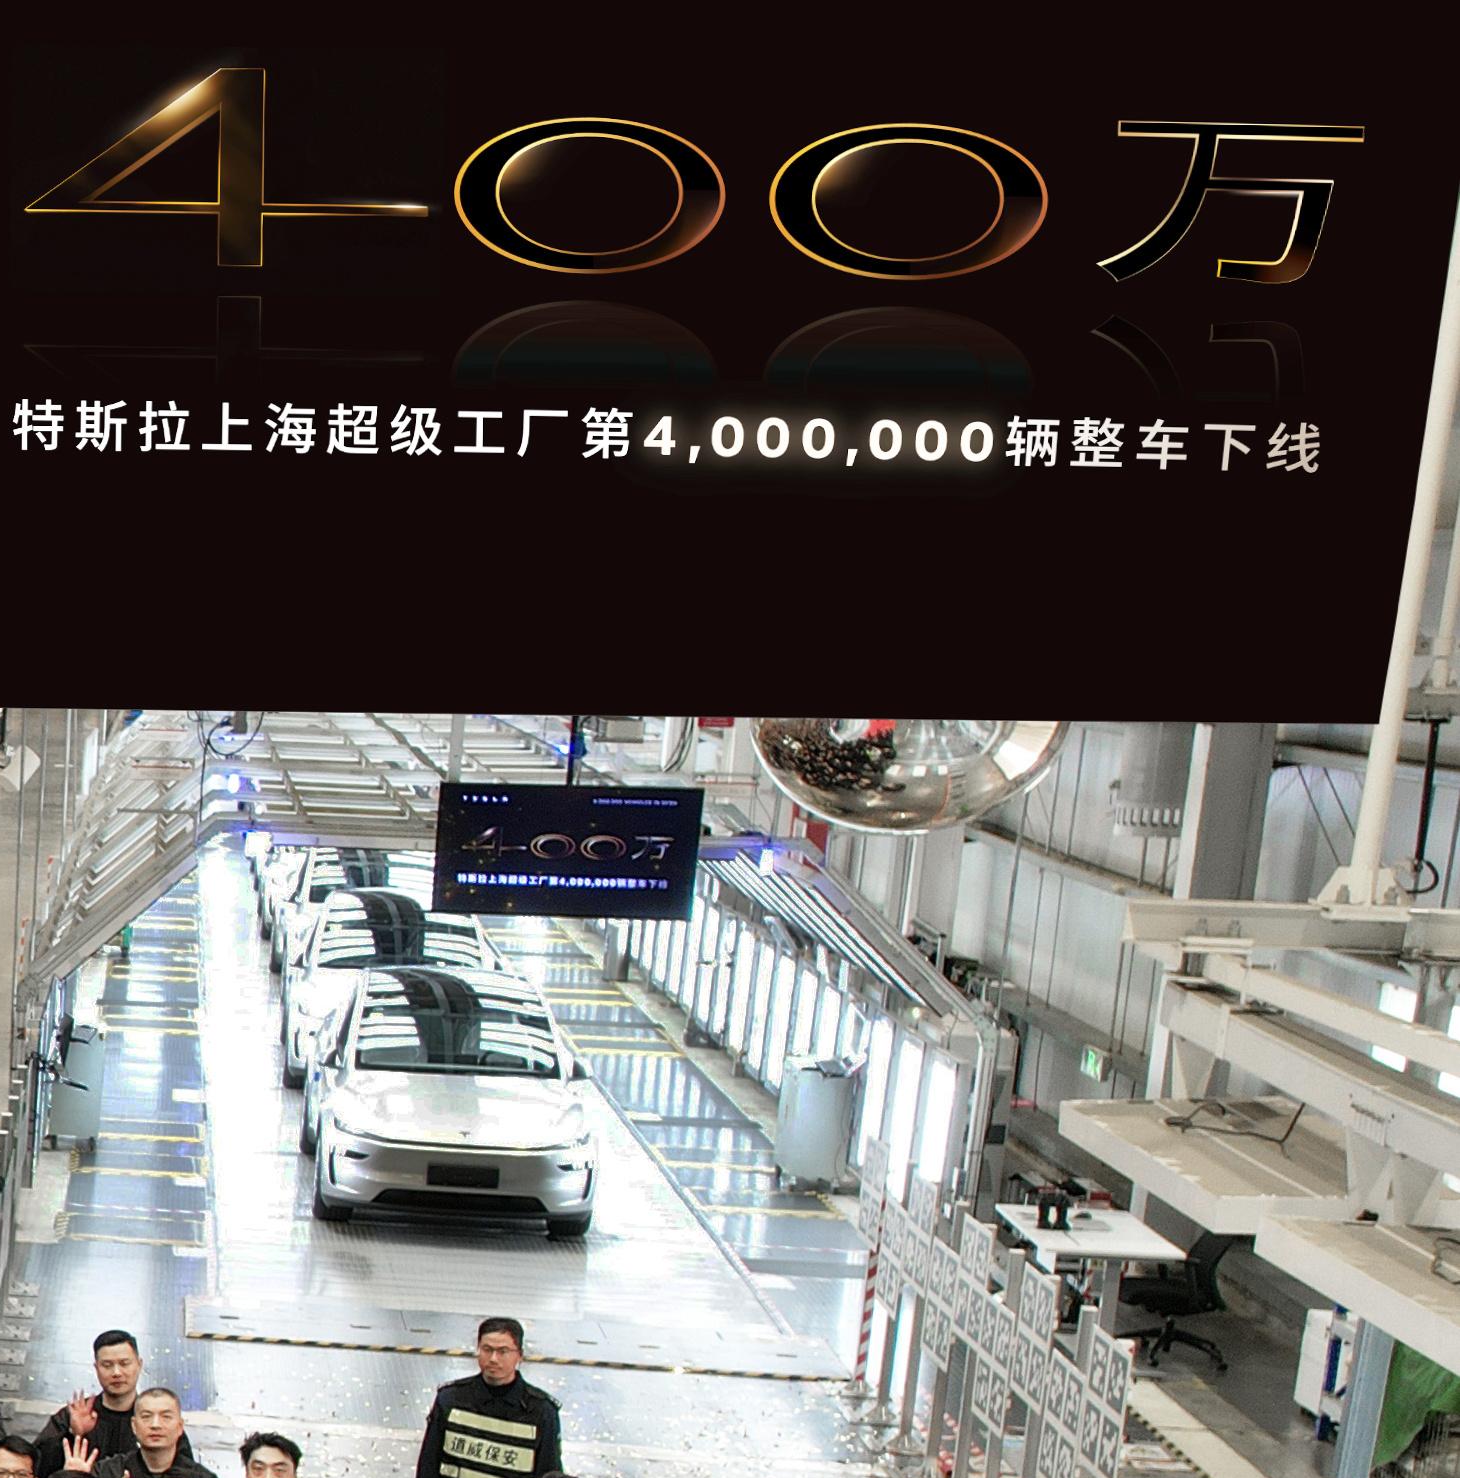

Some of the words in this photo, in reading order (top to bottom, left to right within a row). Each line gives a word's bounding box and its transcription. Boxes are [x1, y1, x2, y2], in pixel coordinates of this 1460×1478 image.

[24, 68, 1365, 284] 400万
[12, 398, 1321, 474] 特斯拉上海超级工厂第4,000,000辆整车下线
[462, 826, 674, 860] 400万
